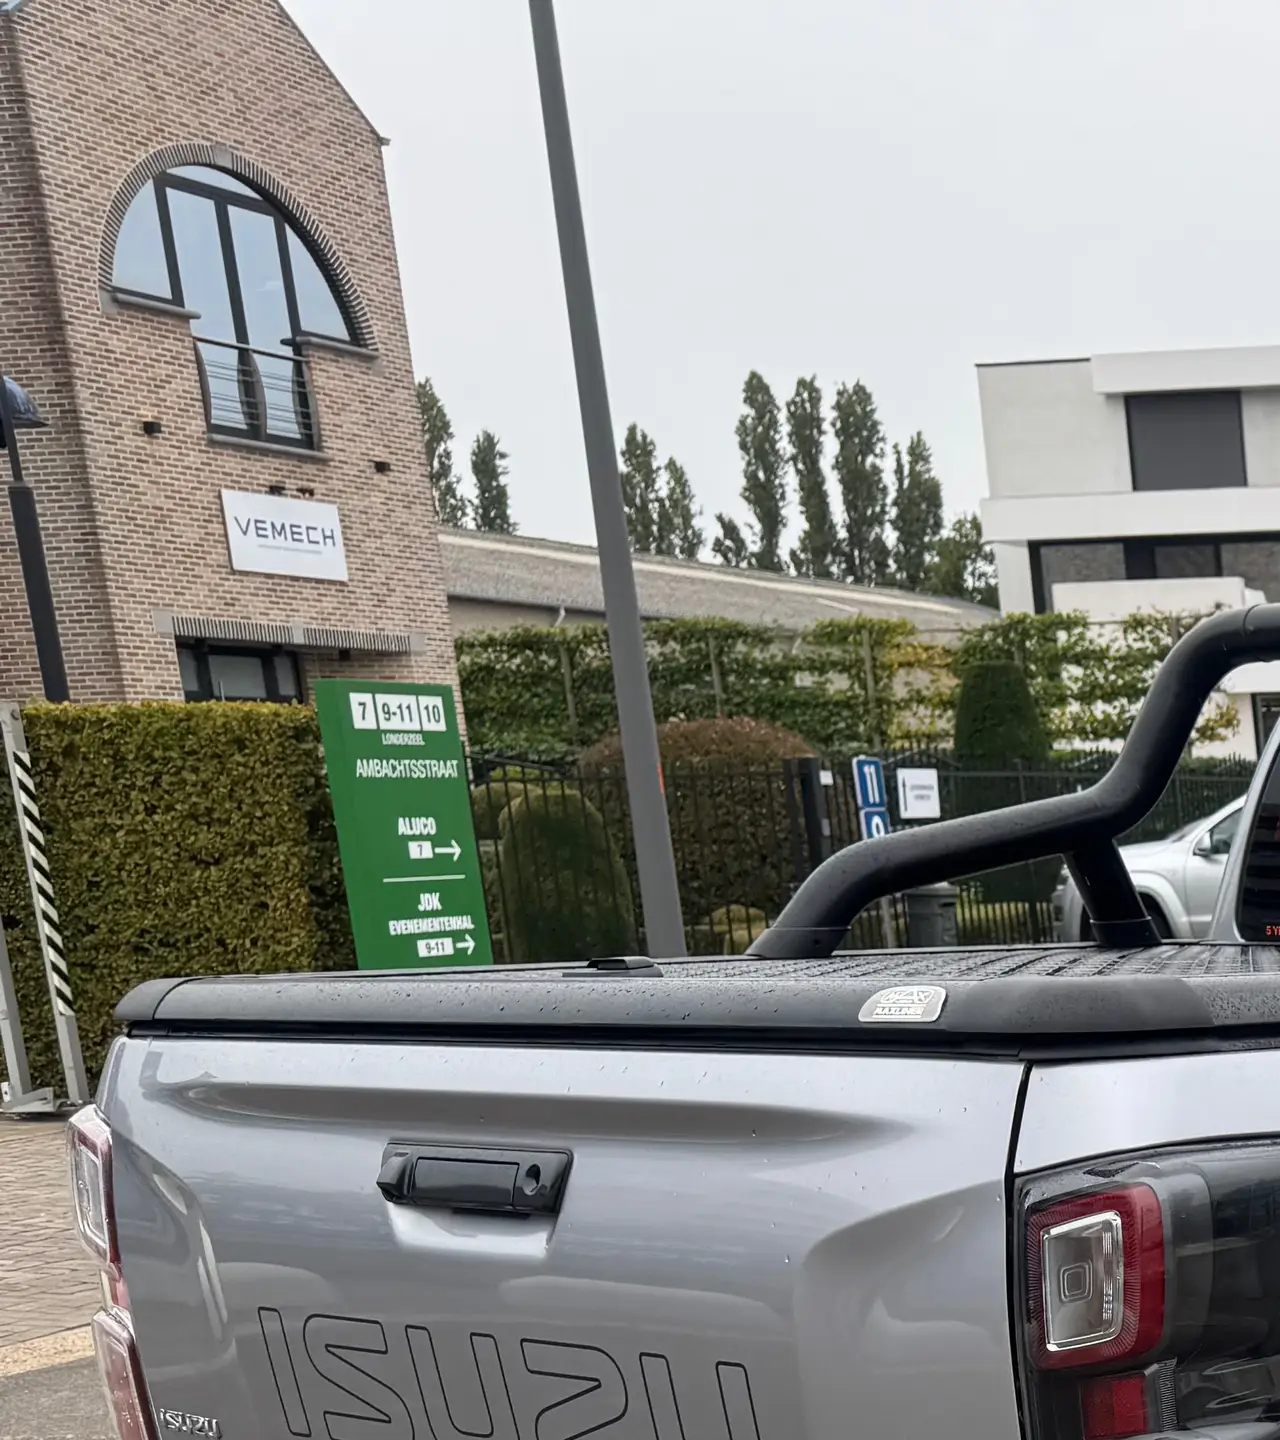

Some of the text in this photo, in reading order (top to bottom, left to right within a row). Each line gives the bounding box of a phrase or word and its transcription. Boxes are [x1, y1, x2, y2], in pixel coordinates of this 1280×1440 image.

[234, 515, 336, 547] VEMECH
[358, 702, 441, 723] 7 9-11 10
[356, 758, 459, 779] AMBACHTSSTRAAT
[863, 765, 880, 804] 11
[398, 816, 437, 836] ALUCO
[417, 844, 424, 857] 7
[418, 892, 442, 912] JDK
[388, 915, 475, 936] EVENEMENTENHAL
[1265, 925, 1272, 936] 5
[425, 941, 445, 955] 9-11
[160, 1408, 222, 1440] ISUZU
